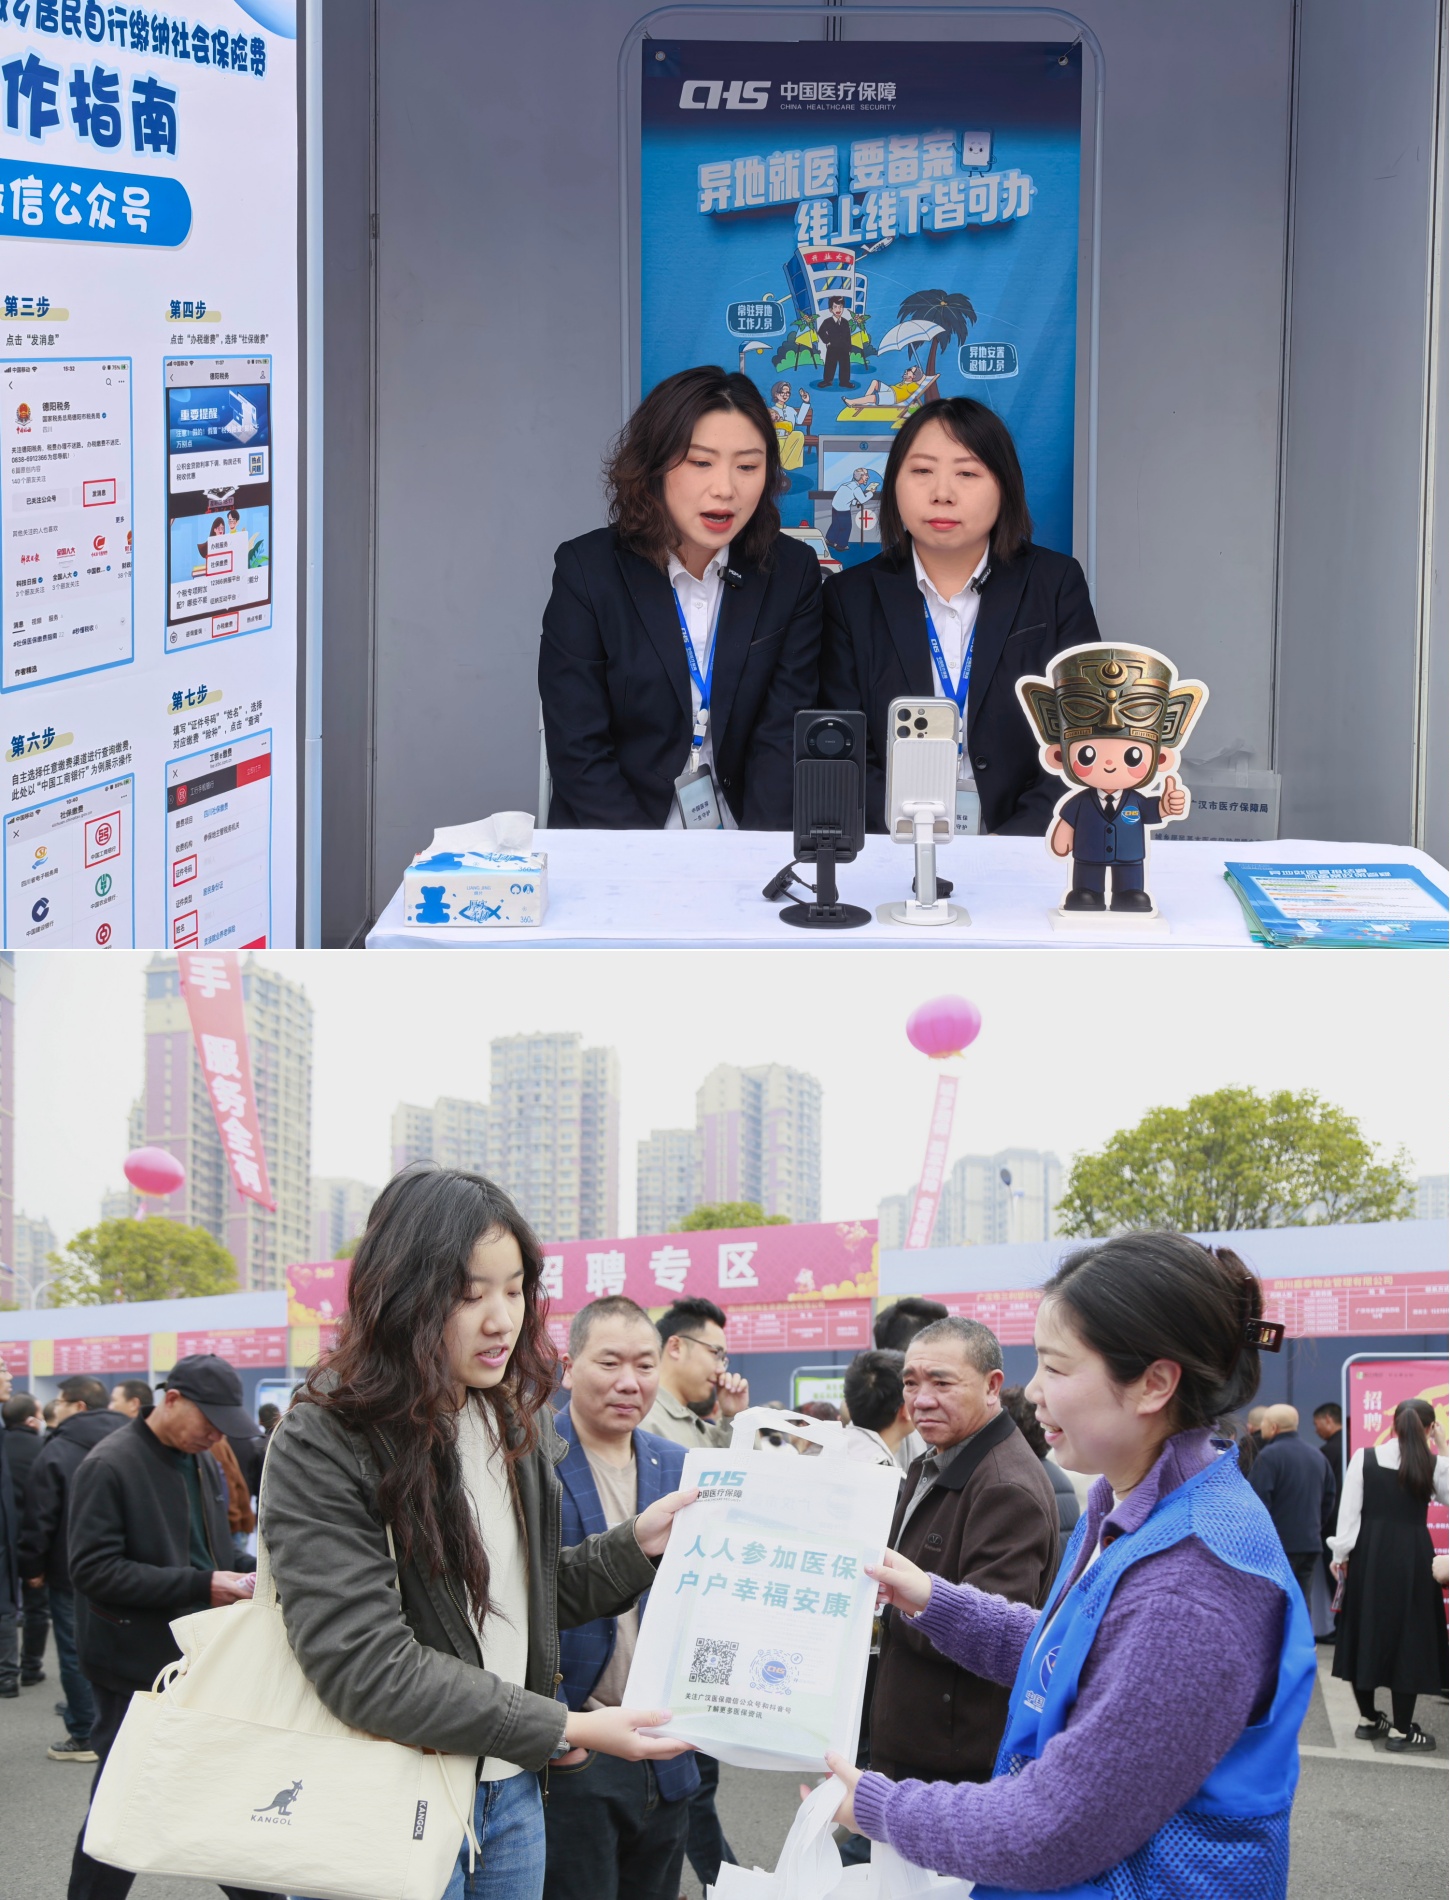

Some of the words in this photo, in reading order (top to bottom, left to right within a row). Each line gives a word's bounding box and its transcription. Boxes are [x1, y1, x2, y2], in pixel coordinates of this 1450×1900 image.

[679, 80, 771, 110] CHS
[780, 81, 897, 101] 中国医疗保障
[2, 53, 176, 155] 作指南
[700, 148, 836, 213] 异地就医
[851, 132, 956, 190] 要备案
[797, 173, 1035, 246] 线上线下皆可办
[4, 295, 50, 318] 第三步
[170, 300, 206, 319] 第四步
[737, 304, 773, 317] 常驻异地
[737, 318, 773, 330] 工作人员
[969, 346, 1005, 359] 异地安置
[969, 359, 1005, 372] 退休人员
[42, 401, 70, 411] 德阳税务
[180, 408, 218, 421] 重要提醒
[172, 684, 207, 711] 第七步
[11, 727, 55, 758] 第六步
[60, 805, 83, 820] 社保缴费
[1191, 800, 1269, 813] 汉市医疗保障局
[1363, 1390, 1383, 1432] 招聘
[697, 1471, 747, 1487] CHS
[697, 1488, 743, 1499] 中国医疗保障
[684, 1535, 857, 1580] 人人参加医保
[675, 1570, 850, 1618] 户户幸福安康
[685, 1692, 792, 1714] 关注广汉医保微信公众号和抖音号
[706, 1704, 763, 1719] 了解更多医保资讯
[250, 1814, 293, 1826] KANGOL
[414, 1801, 427, 1837] KANGOL
